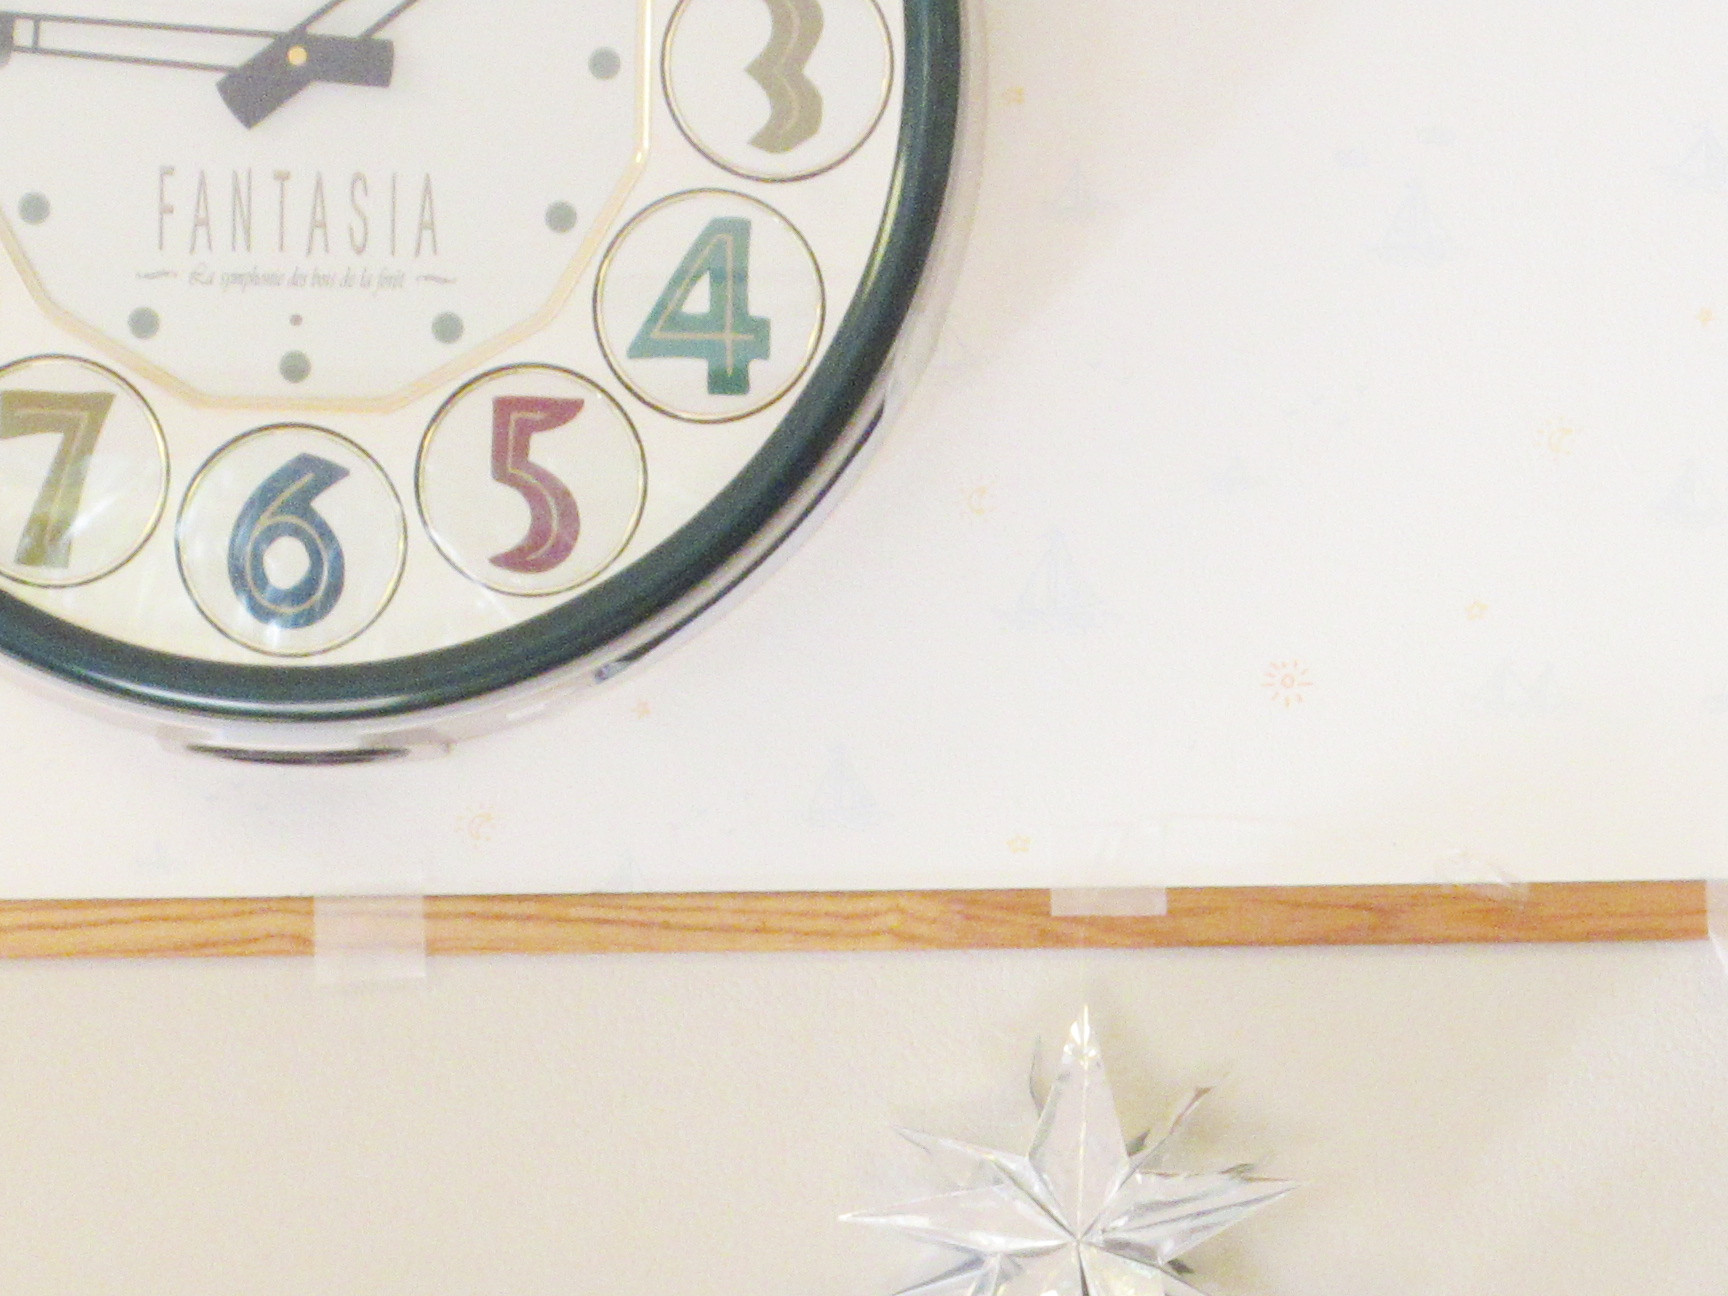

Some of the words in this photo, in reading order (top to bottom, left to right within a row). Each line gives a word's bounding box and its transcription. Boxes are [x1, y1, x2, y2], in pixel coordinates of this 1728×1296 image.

[744, 0, 824, 154] 3
[158, 165, 438, 257] FANTASIA
[628, 215, 770, 395] 4
[227, 452, 351, 630] 6
[488, 397, 584, 574] 5
